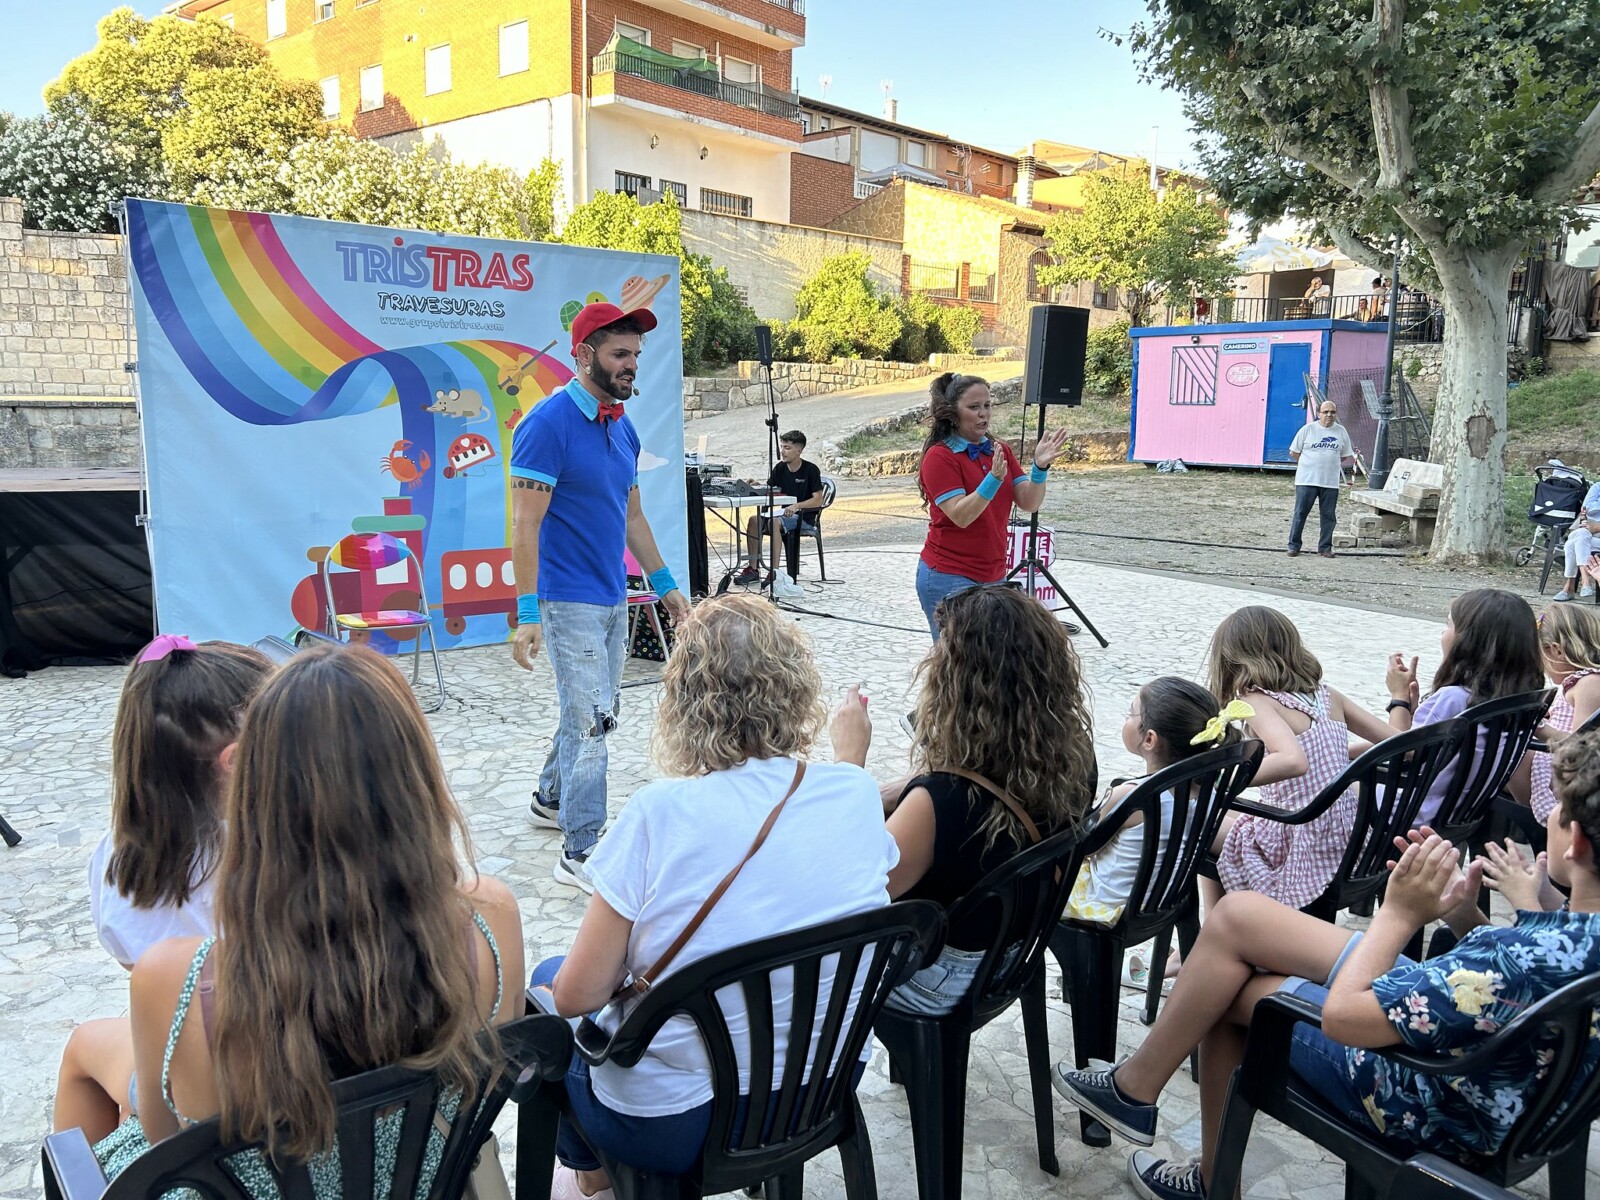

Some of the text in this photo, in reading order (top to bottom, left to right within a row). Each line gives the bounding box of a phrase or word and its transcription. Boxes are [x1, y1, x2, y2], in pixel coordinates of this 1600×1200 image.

[377, 291, 506, 318] TRAVESURAS
[380, 316, 505, 332] www.grupotristras.com
[1223, 343, 1257, 351] CAMERINO
